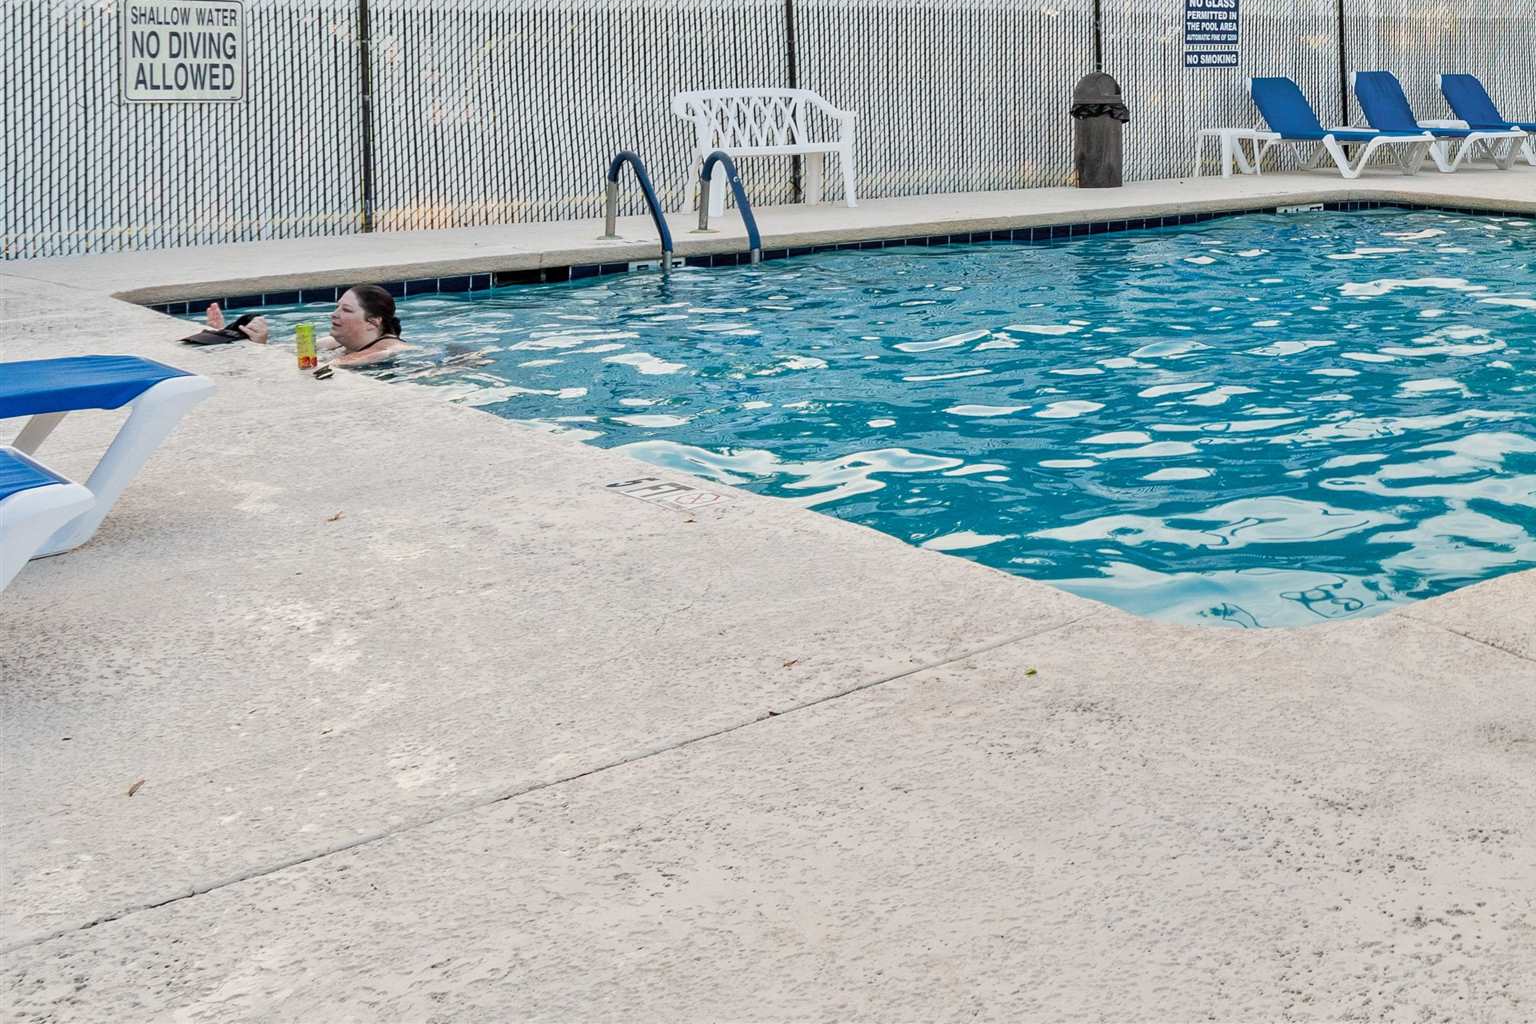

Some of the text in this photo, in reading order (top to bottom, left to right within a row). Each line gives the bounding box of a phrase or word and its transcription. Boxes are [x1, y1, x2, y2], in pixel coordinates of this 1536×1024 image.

[130, 6, 237, 27] SHALLOW WATER
[1187, 10, 1237, 20] PERMITTED IN
[1187, 21, 1237, 31] THE POOL AREA
[131, 30, 237, 60] NO DIVING
[1186, 54, 1237, 65] NO SMOKING
[134, 62, 235, 91] ALLOWED
